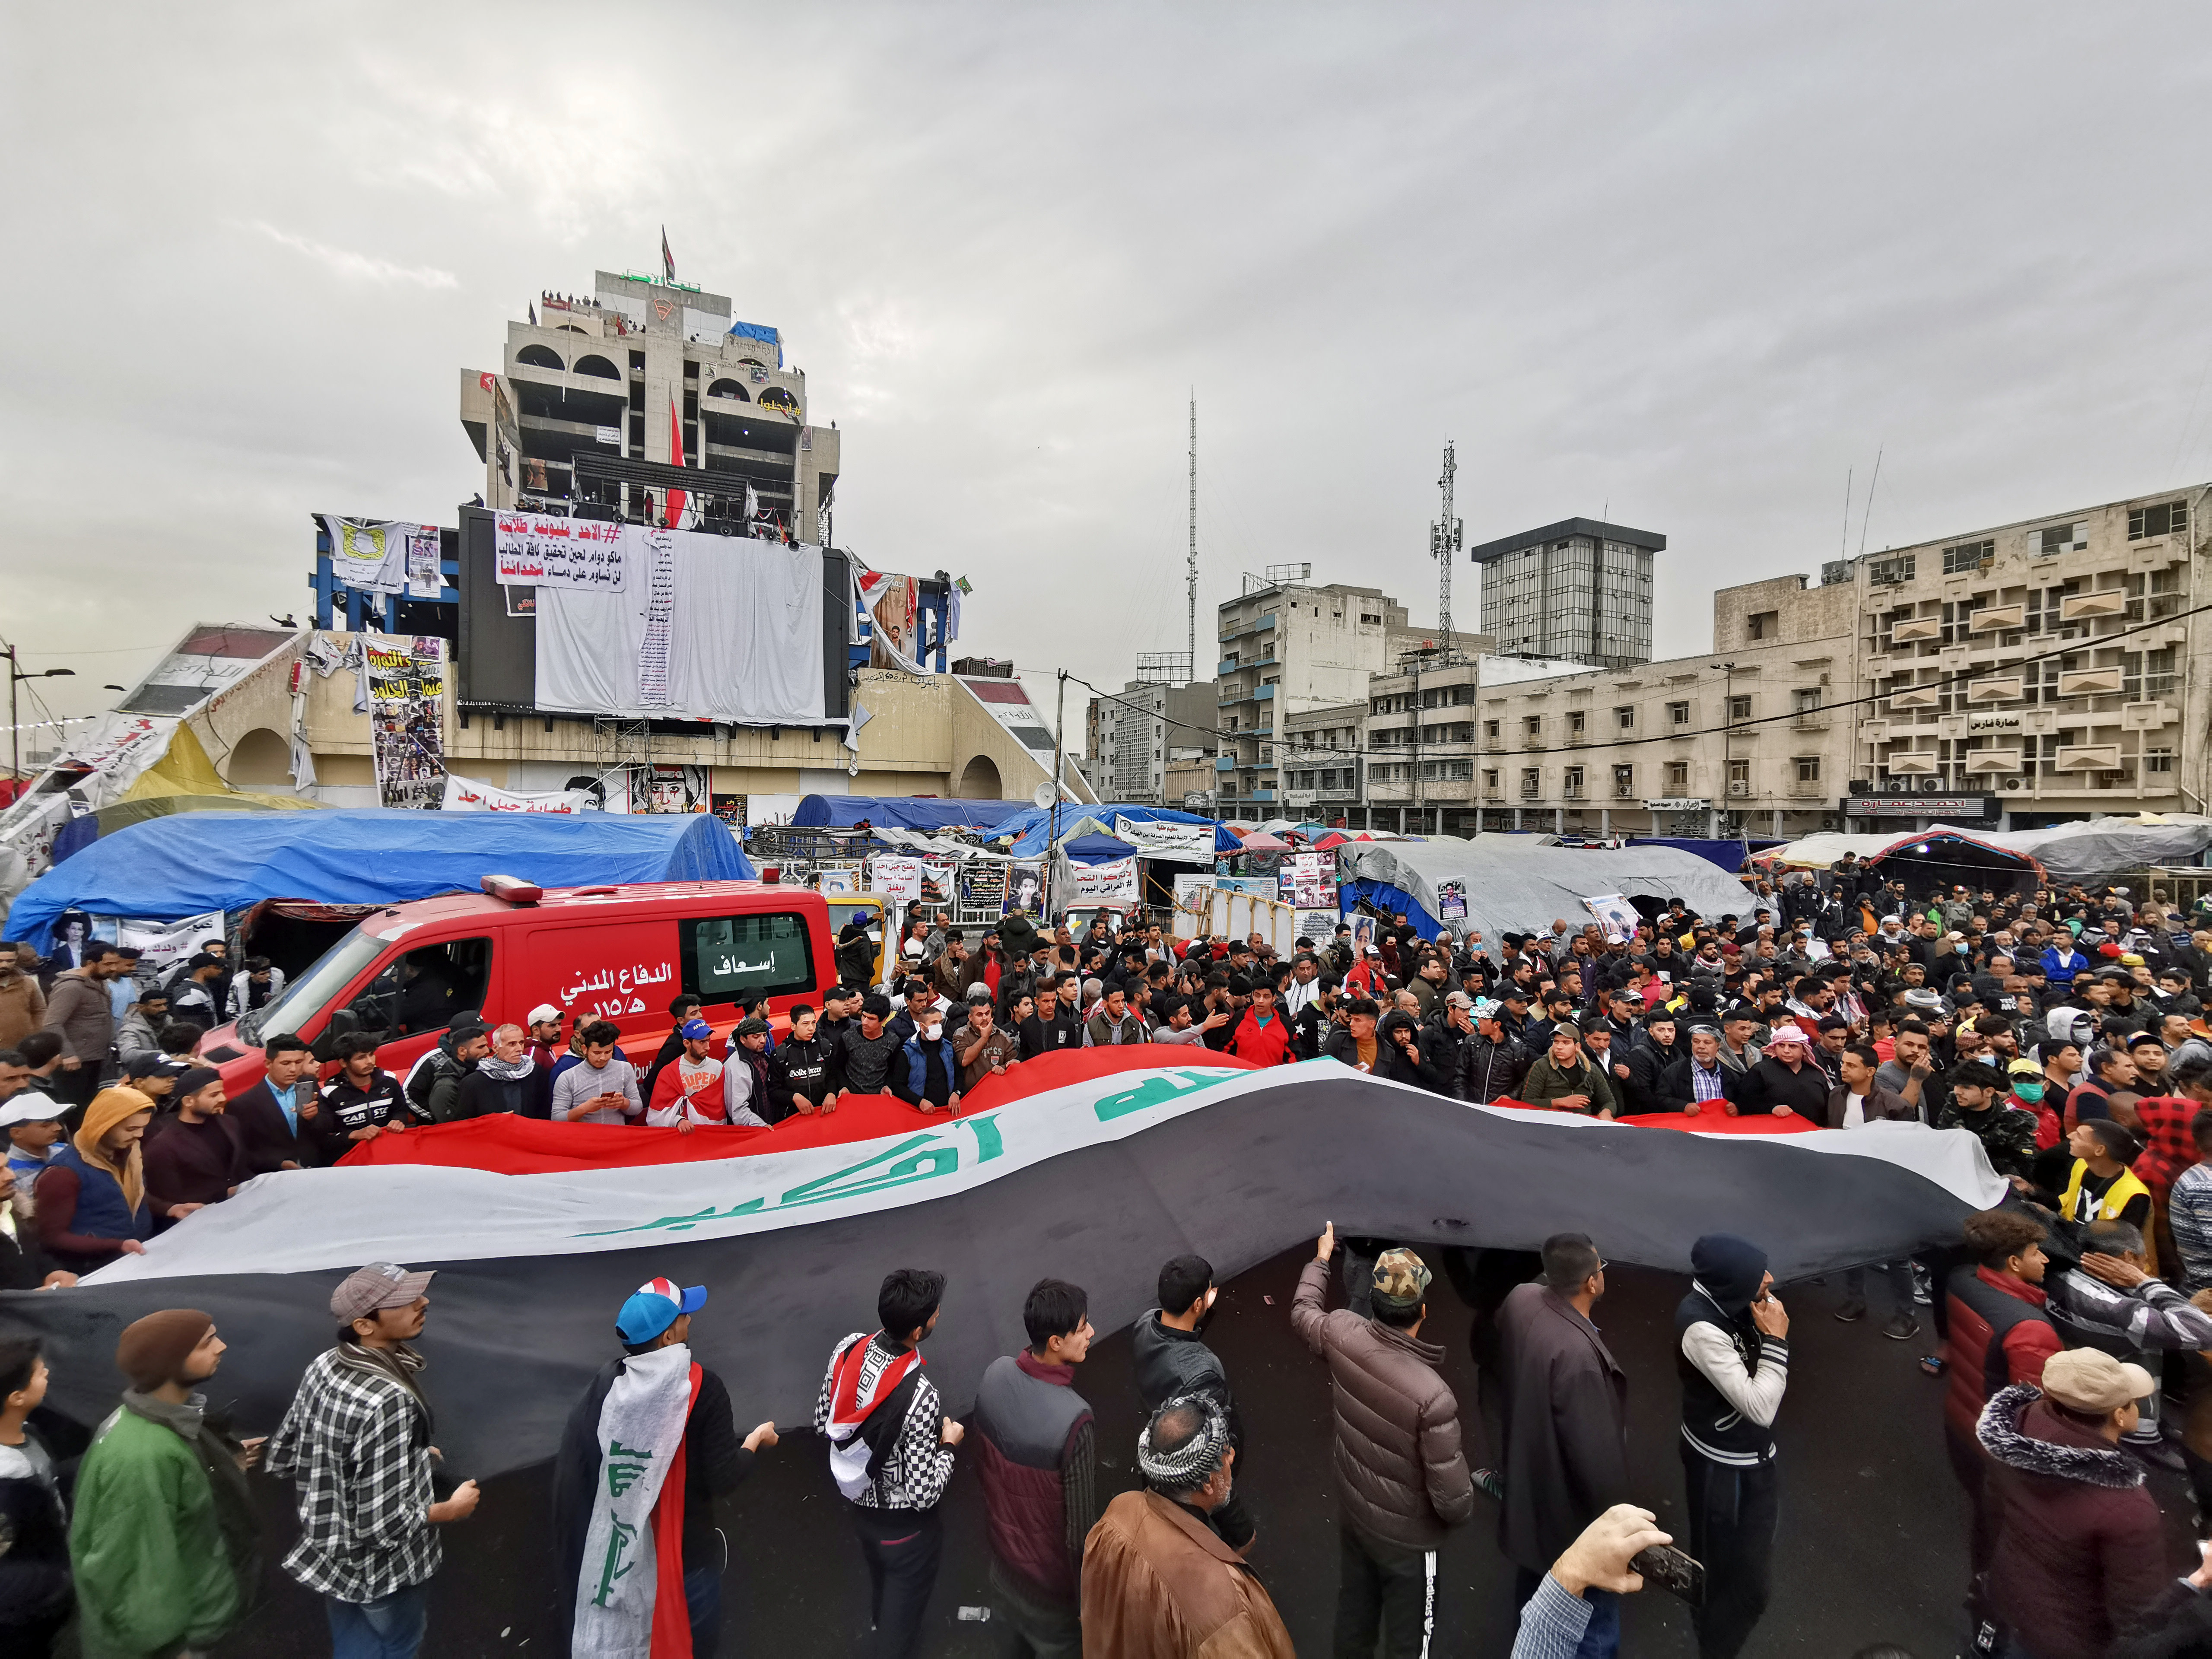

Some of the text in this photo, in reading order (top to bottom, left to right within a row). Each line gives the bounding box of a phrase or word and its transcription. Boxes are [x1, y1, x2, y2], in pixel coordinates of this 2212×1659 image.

[499, 541, 621, 566] ماكو دوام لحين تحقيق كافة المطالب
[588, 569, 610, 584] نساوم
[612, 570, 621, 585] لن
[1970, 718, 2019, 730] عمارة فارس
[902, 863, 915, 871] يفتح
[1081, 885, 1098, 893] اليوم
[714, 951, 775, 976] إسعاف
[561, 962, 672, 1006] الدفاع المدني
[343, 1112, 366, 1122] CAR
[1425, 1576, 1435, 1617] adidas
